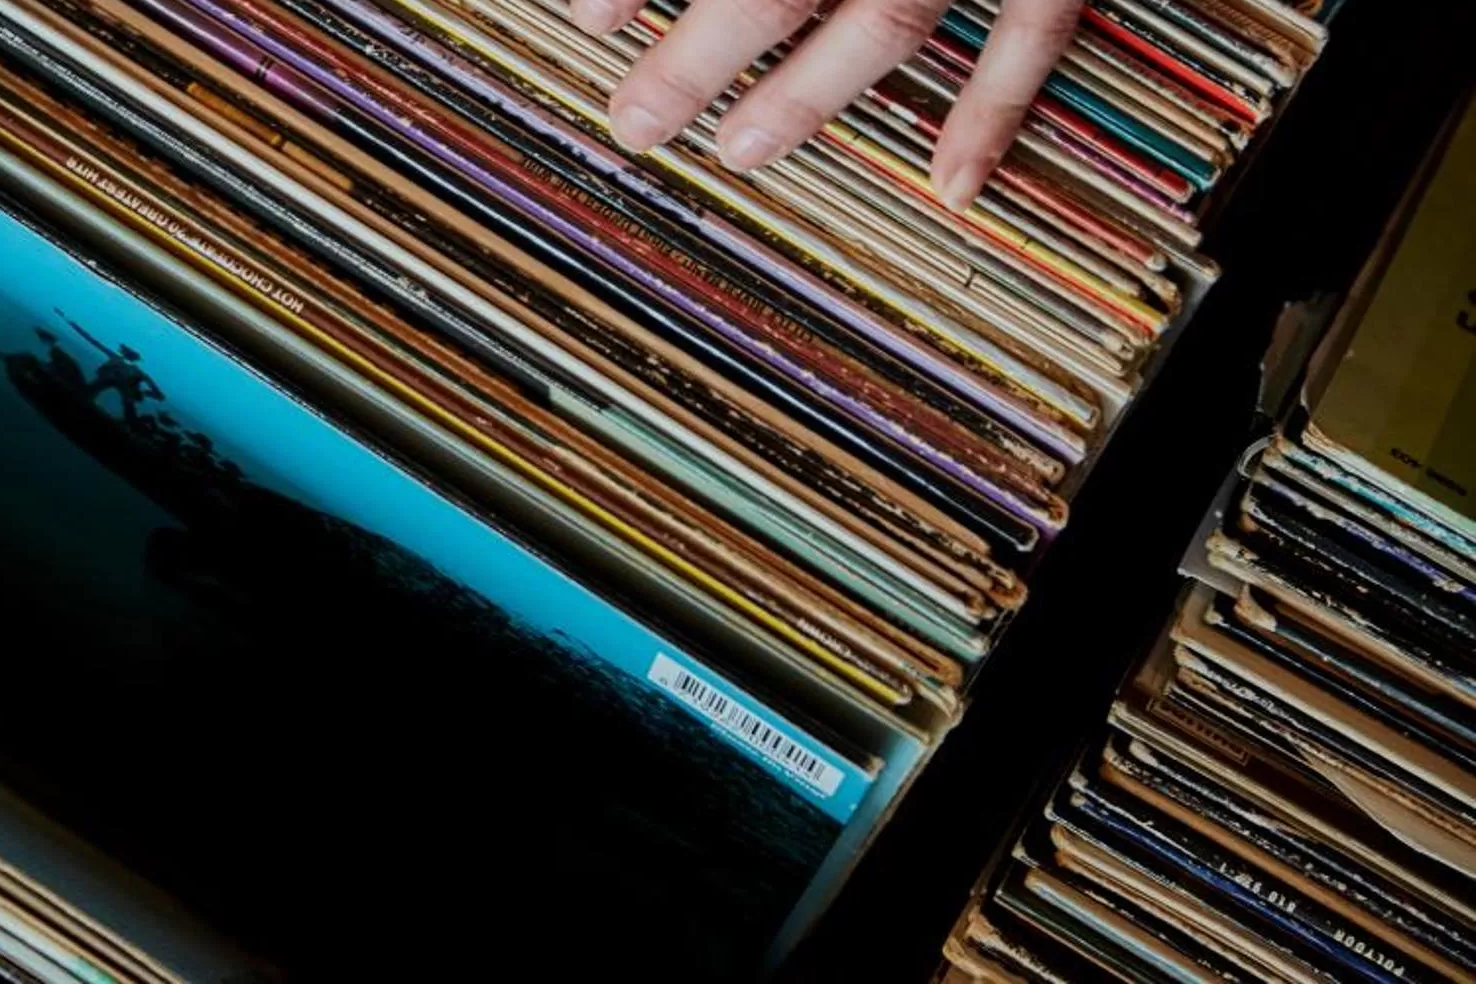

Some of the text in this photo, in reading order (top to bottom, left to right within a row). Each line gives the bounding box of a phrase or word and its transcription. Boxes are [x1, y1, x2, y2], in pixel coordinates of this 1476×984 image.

[64, 154, 100, 183] HITS
[97, 175, 170, 229] GREATEST
[270, 285, 305, 314] HOT
[1333, 928, 1405, 977] POLYDOR
